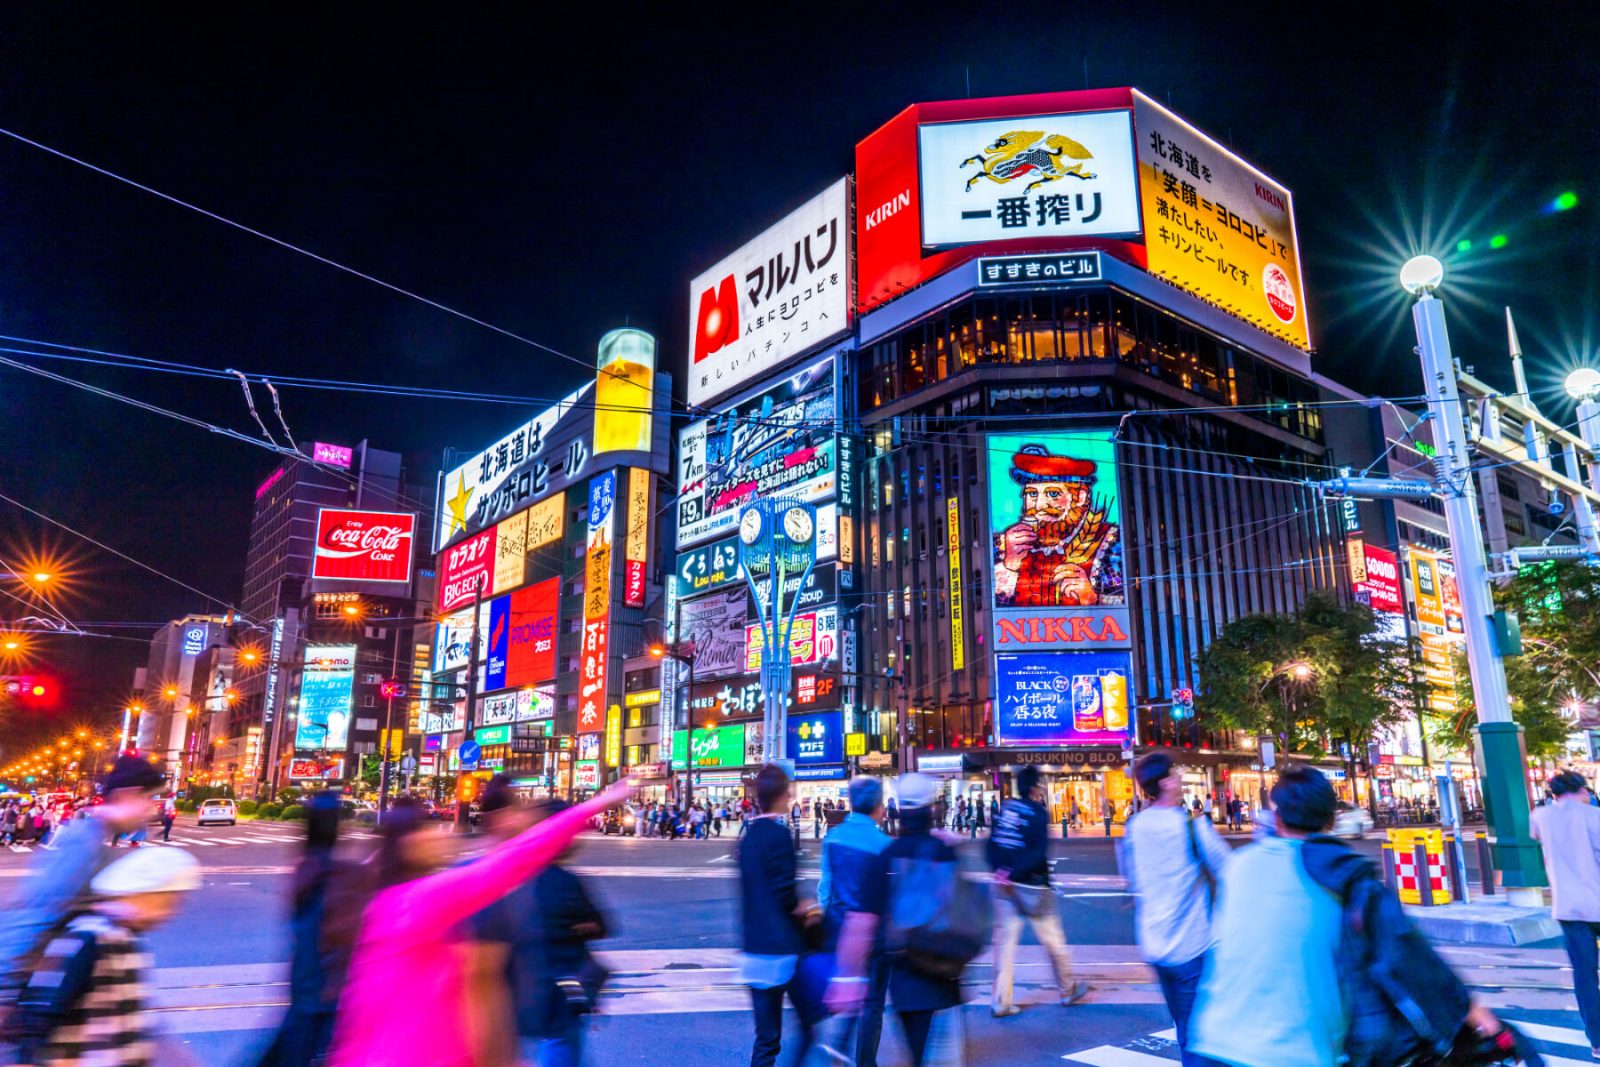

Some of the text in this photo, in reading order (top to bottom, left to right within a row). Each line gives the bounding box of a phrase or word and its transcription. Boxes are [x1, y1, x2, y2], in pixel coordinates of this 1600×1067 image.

[1150, 131, 1212, 183] 北海道を
[865, 188, 911, 231] KIRIN
[961, 191, 1102, 228] 一番搾り
[1254, 182, 1285, 212] KIRIN
[1156, 196, 1224, 249] 満たしたい、
[745, 217, 838, 308] マルハン
[986, 258, 1093, 279] すすきのビル
[745, 273, 839, 336] 人生にヨロコビを
[701, 312, 829, 388] 新しいパチンコへ
[478, 421, 543, 485] 北海道は
[477, 441, 586, 525] サッポロビール
[370, 551, 396, 561] Coke
[449, 536, 490, 571] カラオケ
[682, 545, 735, 583] くろねこ
[1366, 556, 1396, 580] SOUND
[443, 581, 462, 607] BIG
[512, 616, 554, 646] PROMISE
[996, 615, 1128, 645] NIKKA
[817, 679, 833, 695] 2F
[1004, 692, 1064, 704] ハイボール
[1016, 681, 1052, 690] BLACK
[1014, 704, 1057, 719] 香る夜
[1016, 752, 1120, 763] SUSUKINO BLD.
